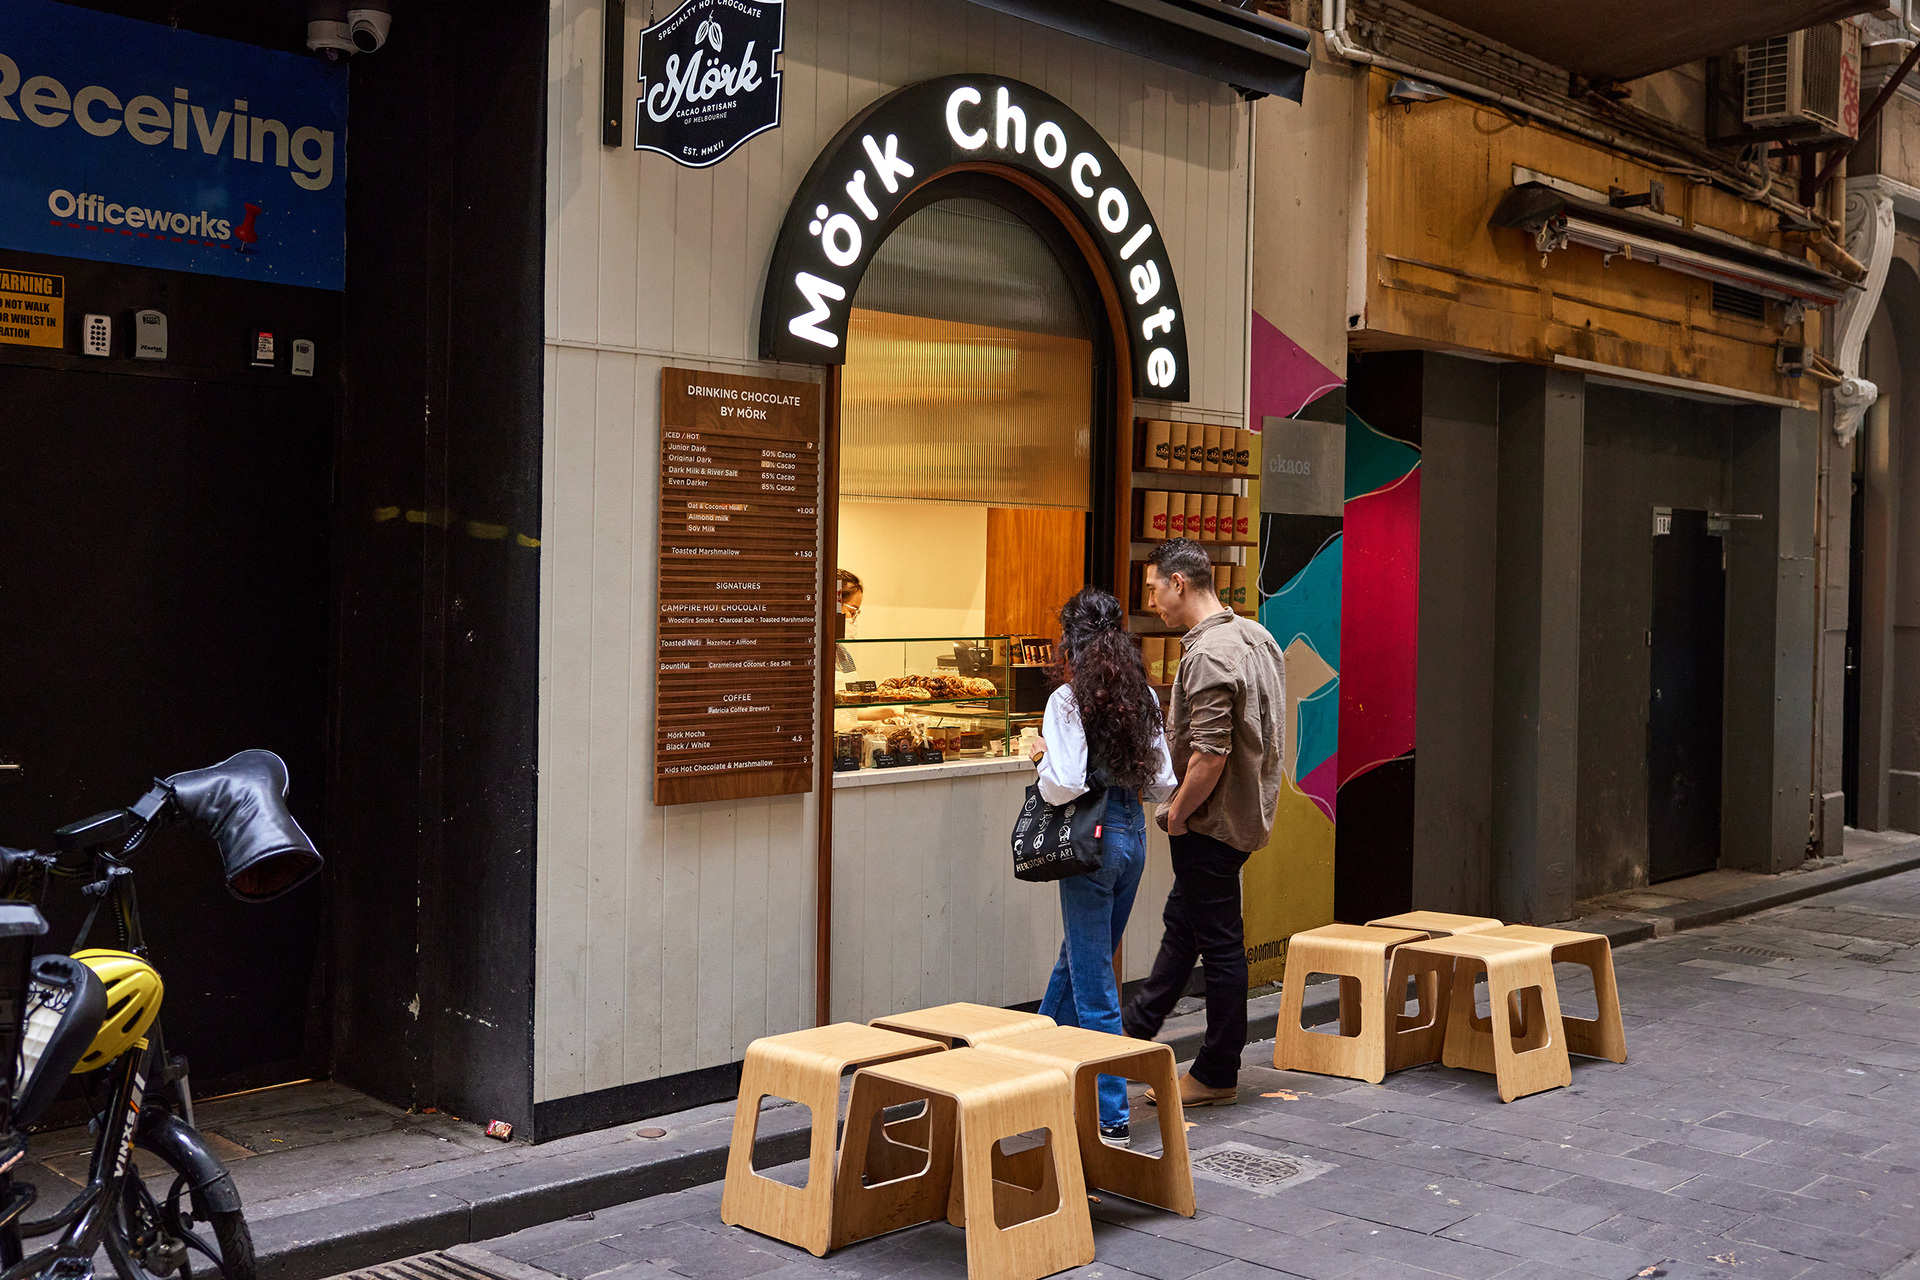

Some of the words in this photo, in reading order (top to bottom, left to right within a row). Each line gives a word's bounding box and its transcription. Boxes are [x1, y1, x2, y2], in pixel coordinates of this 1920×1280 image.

[658, 5, 697, 41] SPECIALTY
[647, 40, 762, 122] Mörk
[676, 106, 700, 118] CACAO
[702, 100, 737, 113] ARTISANS
[693, 112, 728, 124] MELBOURNE
[683, 146, 698, 156] EST.
[701, 140, 724, 156] MMXII
[48, 188, 232, 241] Officeworks
[788, 133, 915, 350] Mörk
[945, 85, 1178, 389] Chocolate
[0, 272, 53, 295] ARNING
[5, 298, 22, 310] NOT
[24, 300, 50, 313] WALK
[11, 314, 45, 326] WHILST
[47, 317, 56, 328] IN
[687, 385, 738, 400] DRINKING
[740, 391, 800, 406] CHOCOLATE
[720, 406, 734, 417] BY
[668, 443, 690, 451] Junior
[777, 450, 796, 458] Cacao
[668, 454, 694, 462] Original
[1269, 454, 1312, 476] ckaos
[672, 547, 698, 555] Toasted
[722, 694, 752, 702] COFFEE
[694, 763, 726, 772] Chocolate
[733, 760, 774, 768] Marshmallow
[1016, 856, 1046, 872] HERSTORY
[1046, 852, 1057, 862] OF
[1060, 848, 1074, 858] ART
[114, 1109, 136, 1178] VINXS
